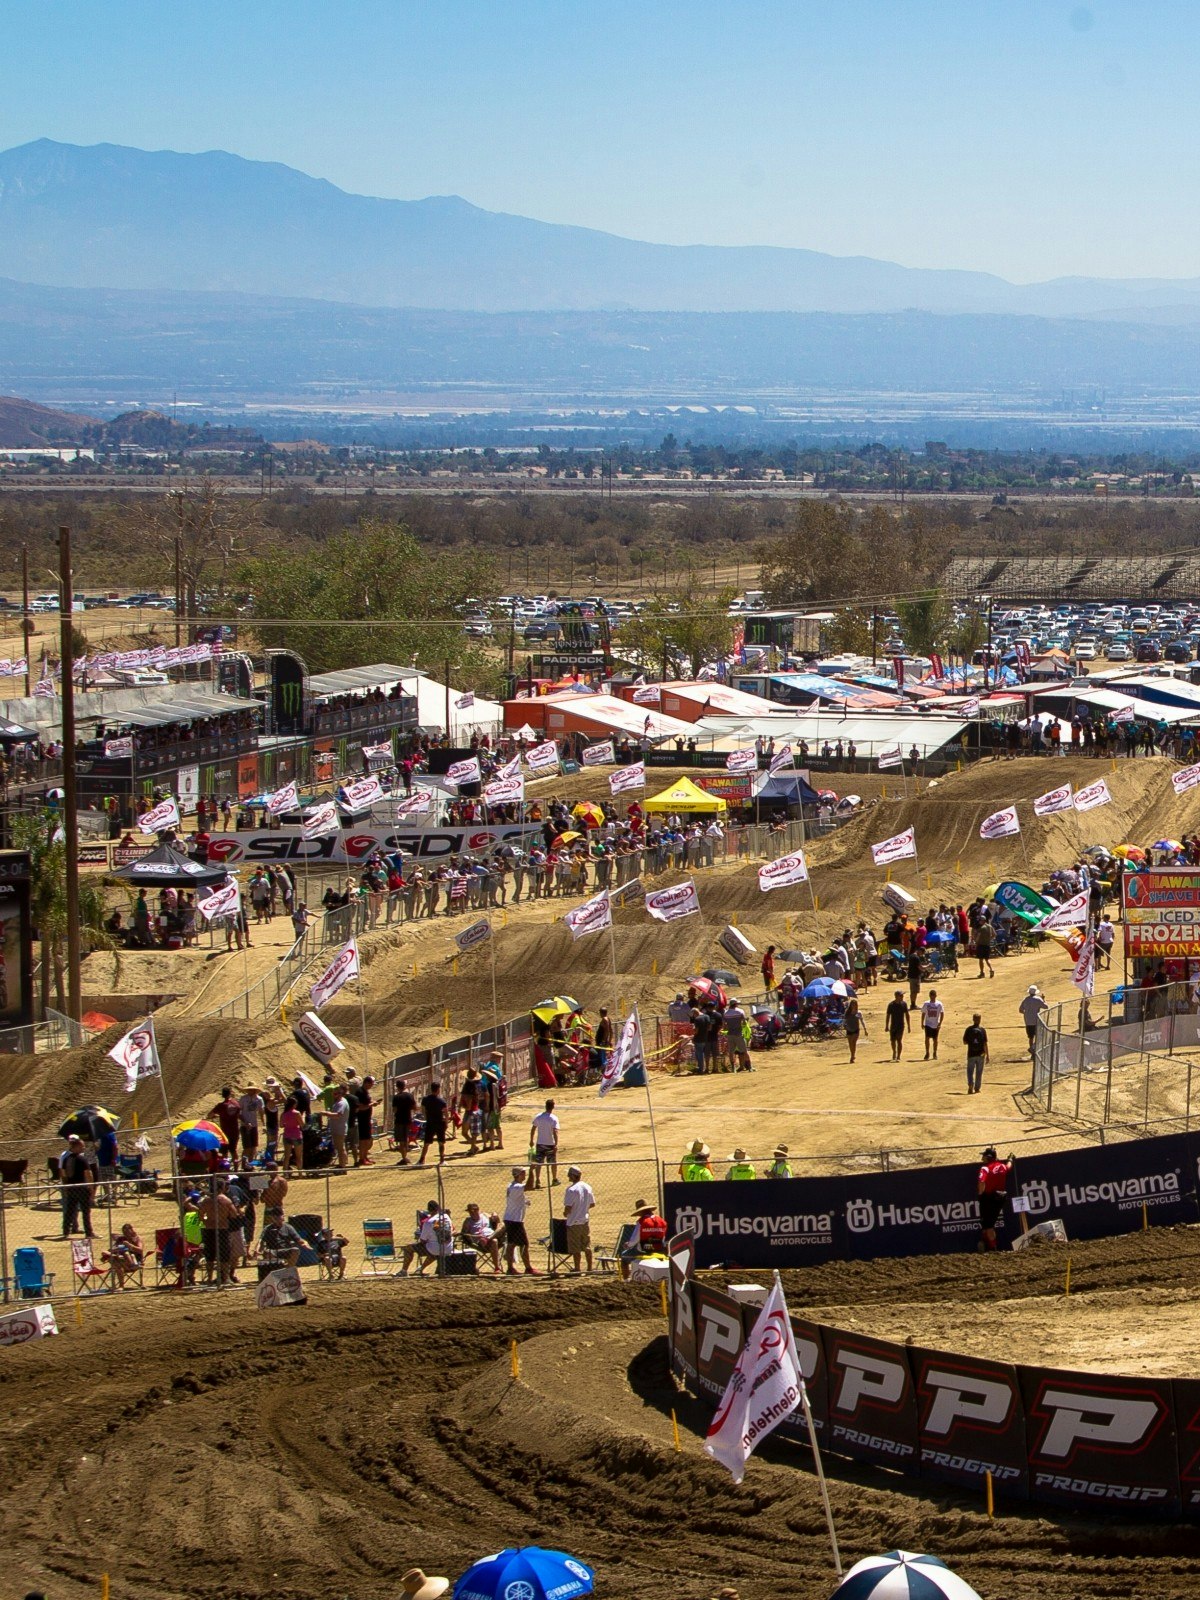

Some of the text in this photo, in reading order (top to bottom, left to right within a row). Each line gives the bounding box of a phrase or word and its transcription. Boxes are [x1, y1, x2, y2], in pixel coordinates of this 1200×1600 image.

[543, 656, 604, 664] PADDOCK
[1149, 891, 1193, 904] SHAVE
[1160, 911, 1194, 922] ICED
[1053, 1173, 1179, 1208] Husqvarna
[1118, 1194, 1181, 1211] MOTORCYCLES
[707, 1213, 831, 1237] Husqvarna
[878, 1200, 1003, 1227] Husqvar
[770, 1236, 832, 1246] MOTORCYCLES
[701, 1303, 741, 1362] P
[836, 1349, 905, 1412] P
[924, 1369, 1013, 1435] P
[1039, 1390, 1158, 1457] P
[832, 1424, 914, 1457] PROGRIP
[920, 1448, 1021, 1480] PROGRIP
[1035, 1472, 1169, 1501] PROGRIP
